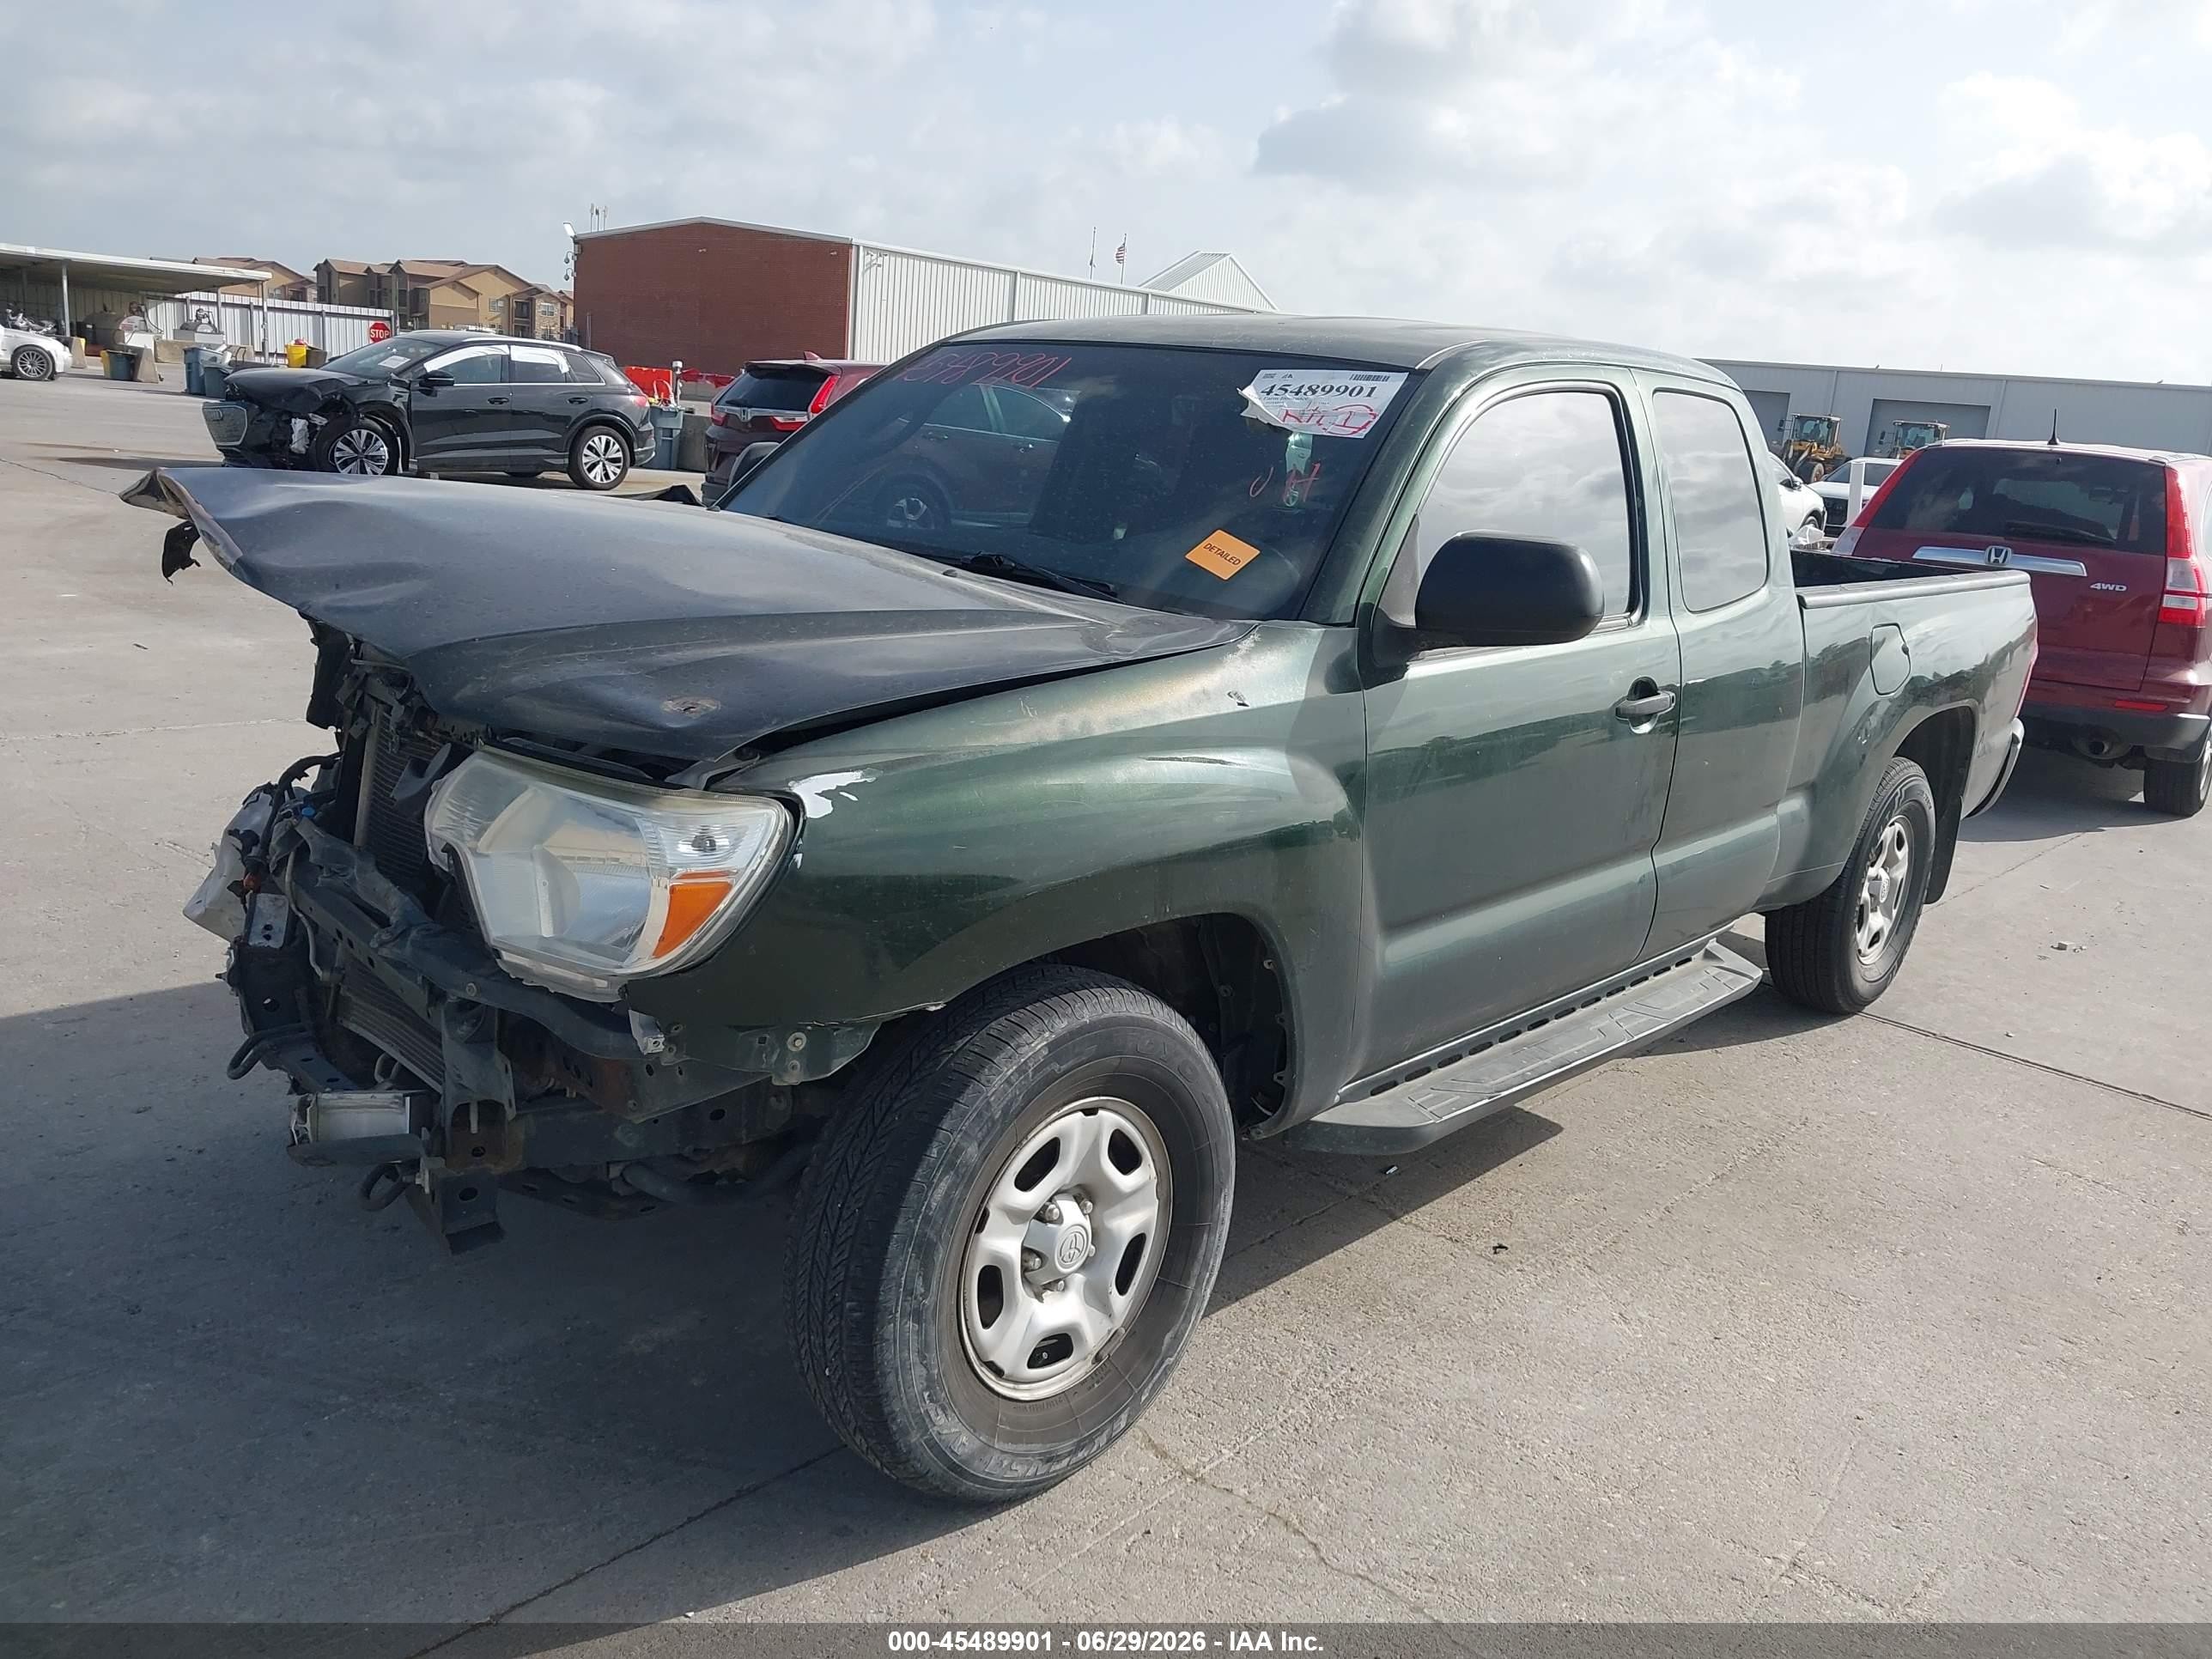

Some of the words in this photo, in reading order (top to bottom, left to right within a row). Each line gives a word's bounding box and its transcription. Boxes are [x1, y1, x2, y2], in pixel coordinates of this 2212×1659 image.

[370, 329, 389, 339] STOP
[1261, 383, 1377, 398] 45489901
[1203, 543, 1241, 566] DETAILED
[2089, 582, 2127, 592] 4WD
